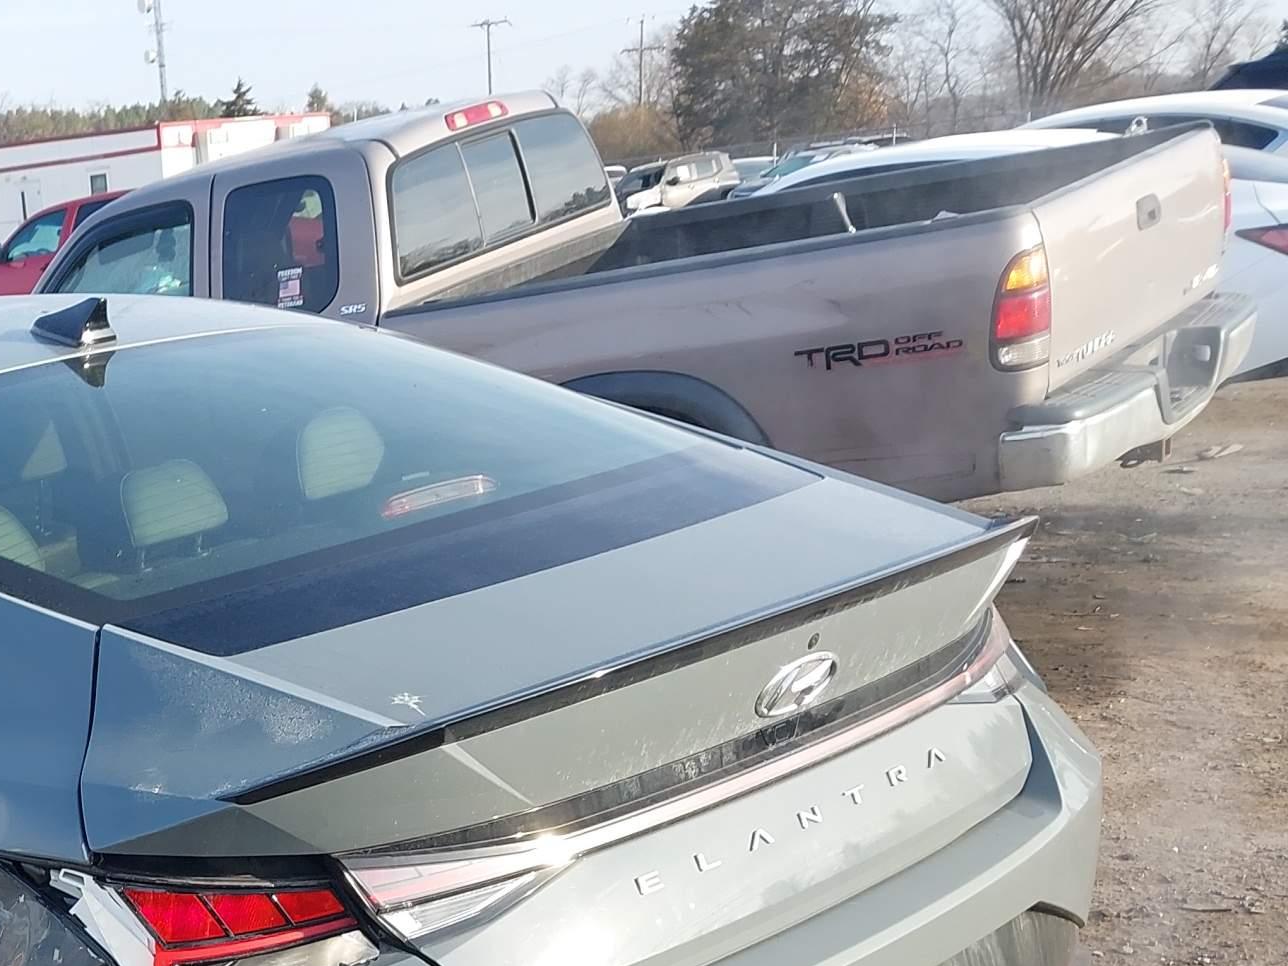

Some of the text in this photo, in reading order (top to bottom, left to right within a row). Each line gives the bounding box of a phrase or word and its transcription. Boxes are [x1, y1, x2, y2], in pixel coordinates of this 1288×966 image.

[340, 303, 367, 316] SR5
[894, 330, 943, 345] OFF
[794, 339, 890, 370] TRD
[895, 339, 964, 356] ROAD
[633, 747, 946, 896] ELANTRA
